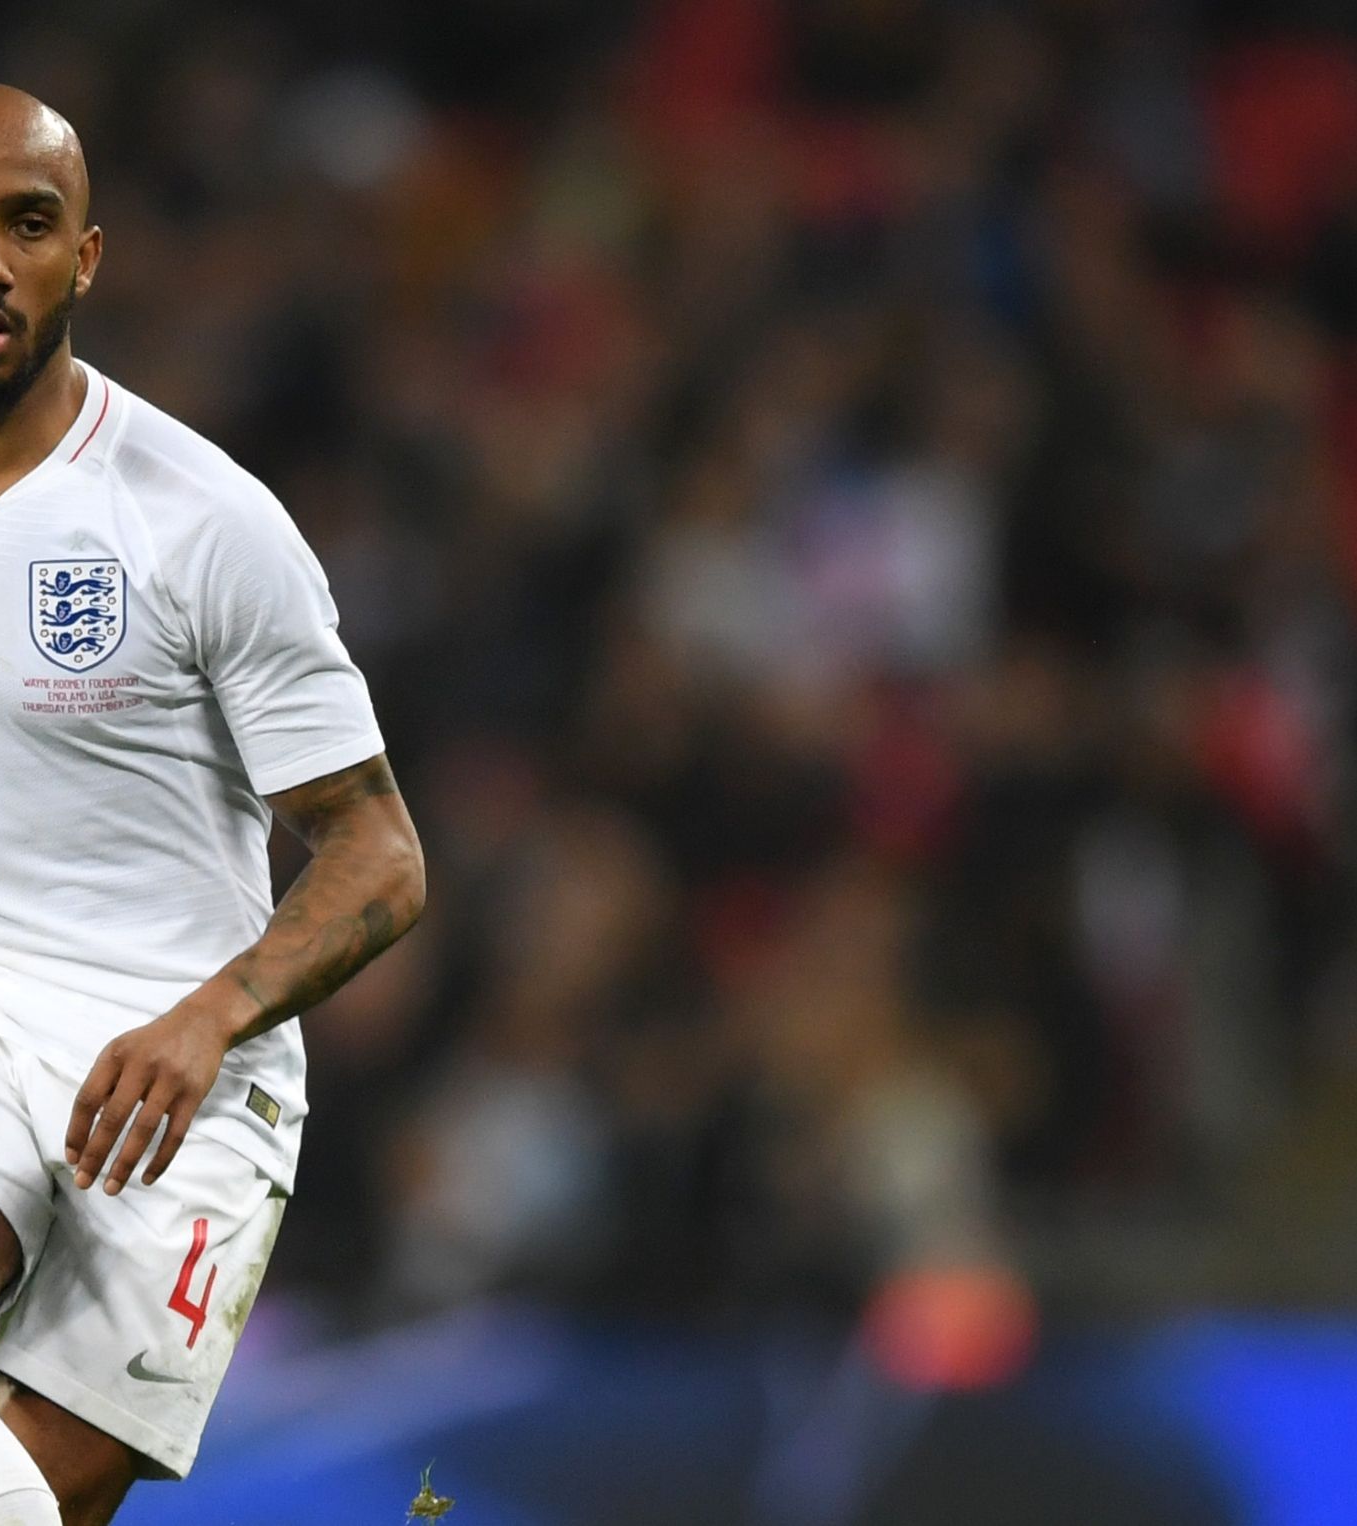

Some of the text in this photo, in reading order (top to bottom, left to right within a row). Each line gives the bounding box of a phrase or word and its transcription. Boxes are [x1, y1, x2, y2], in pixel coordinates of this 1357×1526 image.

[23, 677, 140, 689] WAYNE ROONEY FOUNDATION
[47, 690, 88, 702] ENGLAND
[98, 690, 116, 700] USA
[22, 702, 65, 713] THURSDAY
[67, 703, 76, 713] 15
[78, 701, 125, 714] NOVEMBER
[167, 1218, 218, 1351] 4
